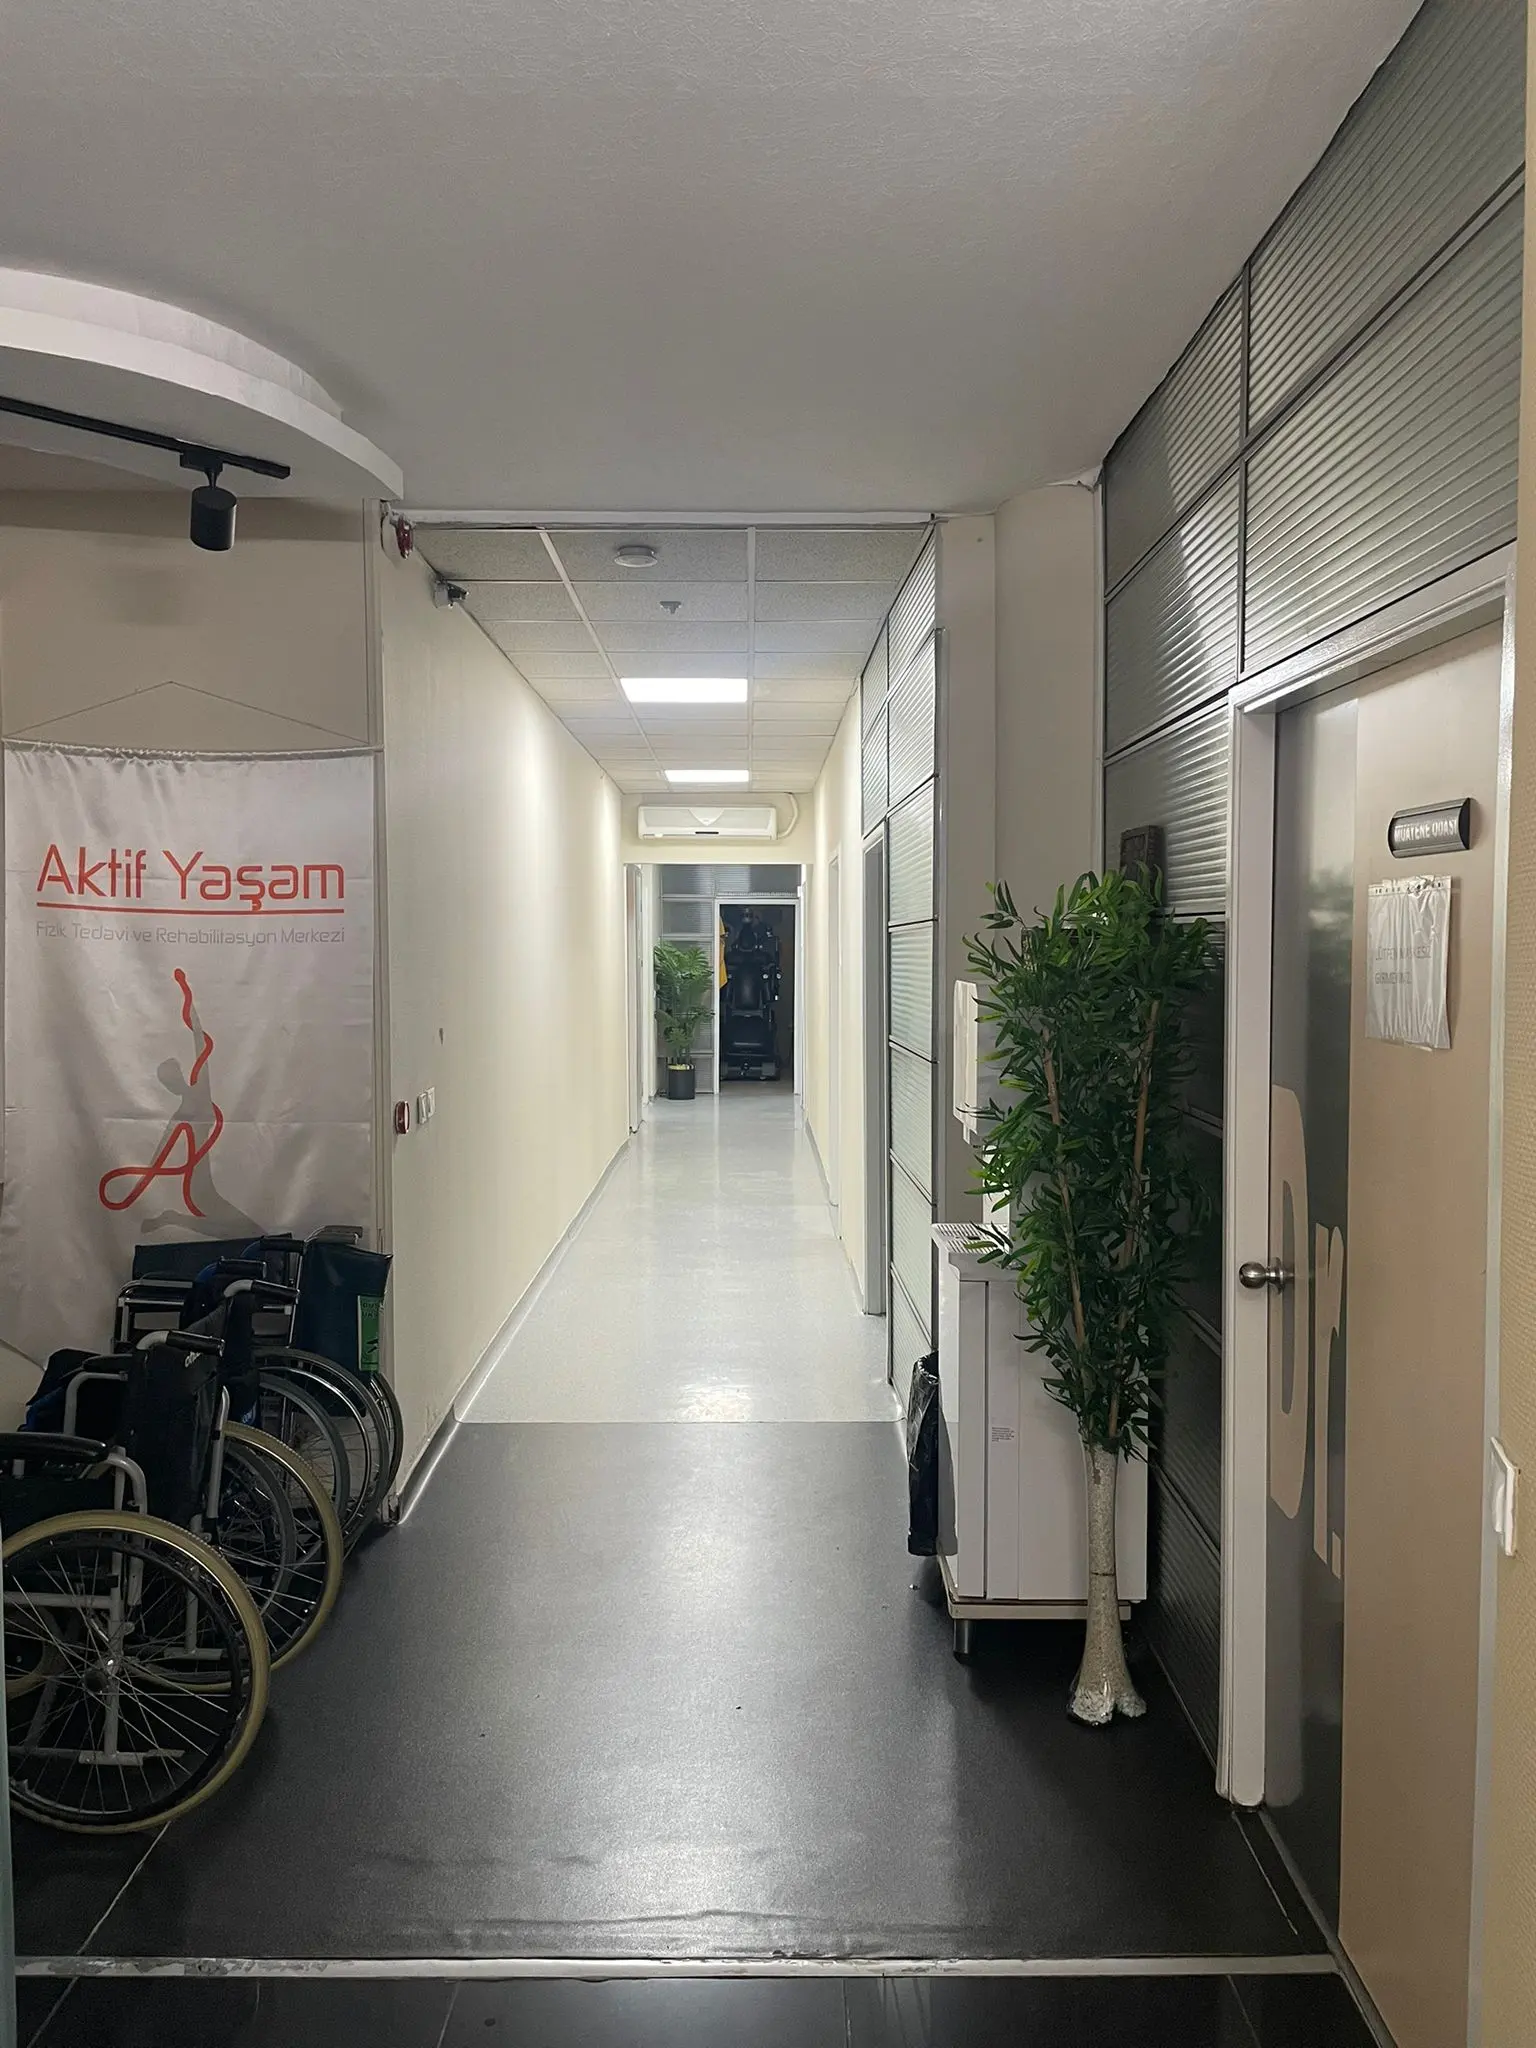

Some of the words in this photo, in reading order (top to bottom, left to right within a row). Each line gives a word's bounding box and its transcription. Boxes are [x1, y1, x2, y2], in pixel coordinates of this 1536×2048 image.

[36, 843, 147, 900] Aktif
[162, 850, 345, 912] Yaşam
[36, 920, 67, 939] Fizik
[71, 922, 129, 942] Tedavi
[132, 930, 152, 943] ve
[155, 927, 277, 948] Rehabilitasyon
[280, 926, 346, 943] Merkezi
